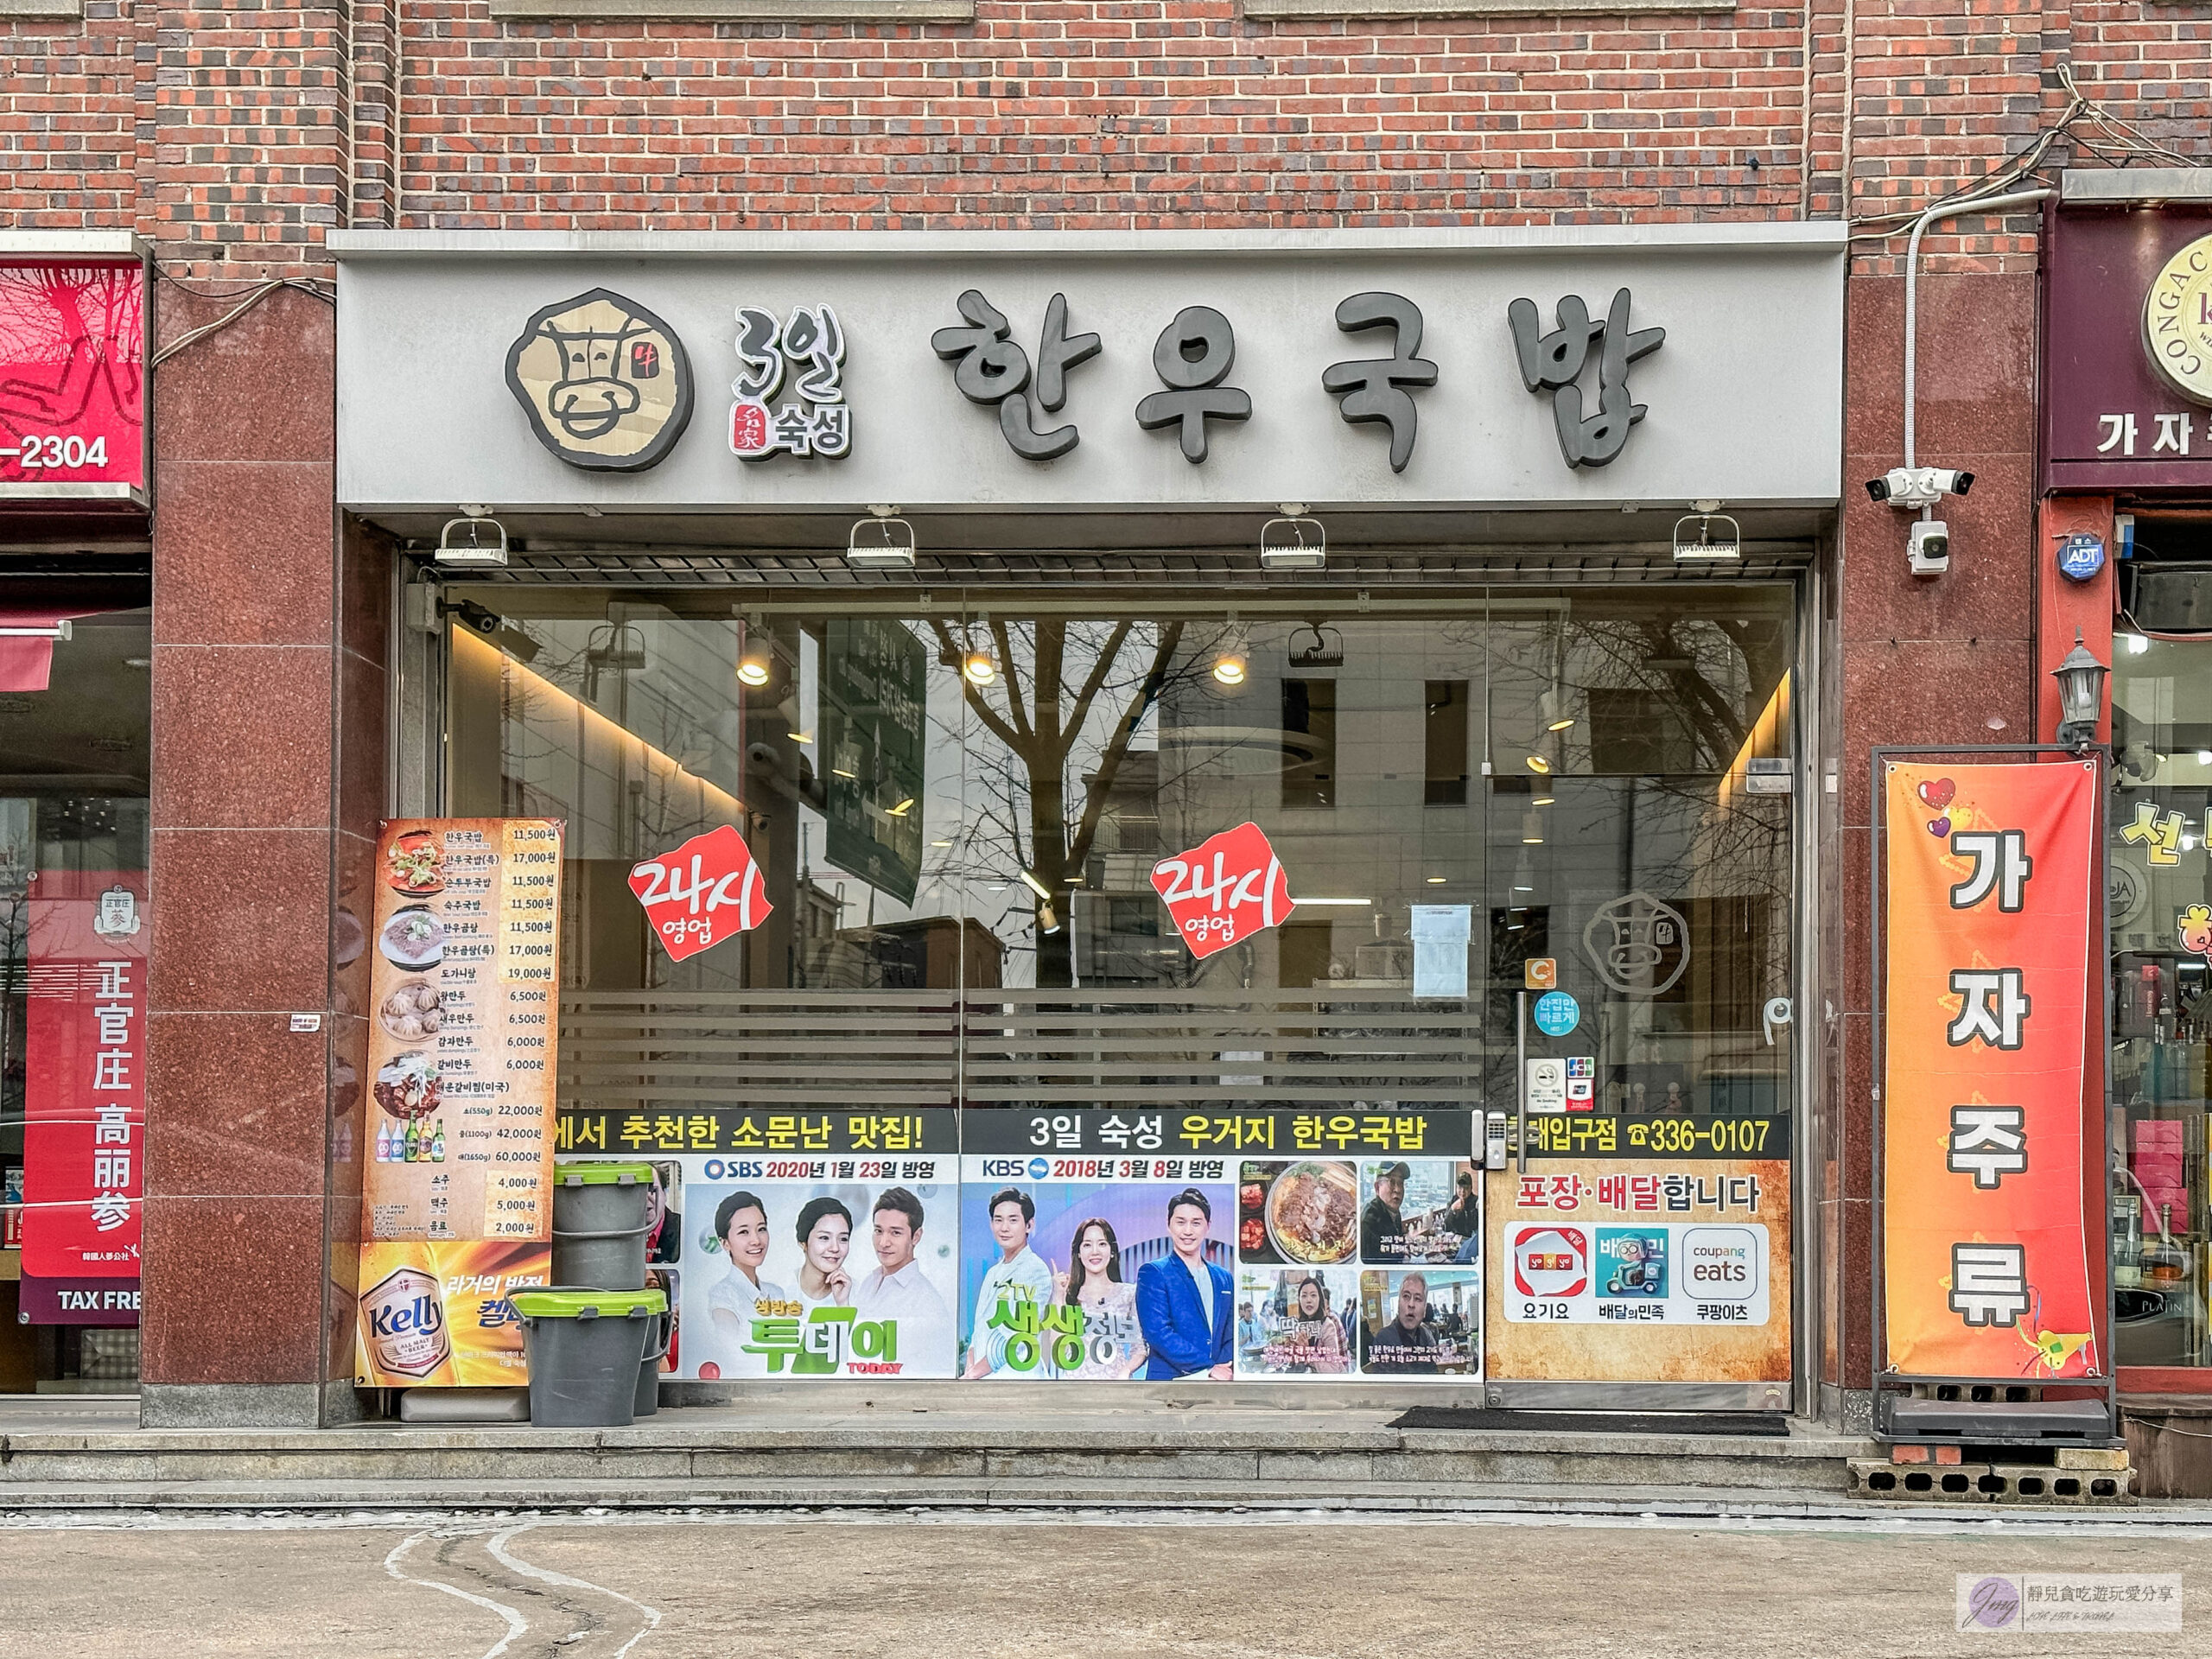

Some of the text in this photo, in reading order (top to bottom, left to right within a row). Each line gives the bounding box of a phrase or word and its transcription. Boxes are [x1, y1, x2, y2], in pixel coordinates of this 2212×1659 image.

[734, 304, 845, 402] 3일
[931, 287, 1666, 473] 한우국밥
[774, 404, 849, 454] 숙성
[2097, 412, 2212, 455] 가자
[2068, 548, 2099, 564] ADT
[513, 829, 556, 841] 11,500원
[512, 852, 556, 864] 17,000원
[512, 874, 554, 887] 11,500원
[1154, 850, 1280, 928] 24시
[632, 853, 758, 931] 24시
[512, 898, 553, 910] 11,500원
[510, 920, 552, 933] 11,500원
[662, 917, 712, 944] 영업
[1185, 914, 1236, 941] 영업
[509, 944, 552, 957] 17,000원
[508, 967, 550, 979] 19,000원
[510, 991, 546, 1002] 6,500원
[92, 960, 134, 1091] 正官庄
[509, 1014, 545, 1025] 6,500원
[507, 1037, 544, 1048] 6,000원
[506, 1059, 543, 1071] 6,000원
[1948, 830, 2033, 1327] 가자주류
[498, 1105, 543, 1116] 22,000원
[497, 1128, 541, 1139] 42,000원
[620, 1115, 720, 1150] 추천한
[731, 1116, 832, 1150] 소문난
[849, 1115, 923, 1150] 맛집!
[1029, 1115, 1427, 1150] 3일 숙성 우거지 한우국밥
[1650, 1120, 1770, 1152] 336-0107
[495, 1152, 540, 1162] 60,000원
[90, 1103, 133, 1233] 高丽参
[727, 1161, 935, 1179] SBS 2020년 1월 23일 방영
[982, 1160, 1025, 1177] KBS
[1053, 1160, 1115, 1178] 2018년
[1119, 1160, 1149, 1179] 3월
[1154, 1160, 1184, 1179] 8일
[1188, 1160, 1224, 1179] 방영
[431, 1174, 537, 1189] 소주 4,000원
[430, 1198, 536, 1211] 맥주 5,000원
[429, 1221, 535, 1234] 음료 2,000원
[1694, 1246, 1745, 1259] coupang
[1694, 1261, 1746, 1281] eats
[448, 1275, 499, 1294] 라거의
[57, 1291, 99, 1310] TAX
[369, 1294, 443, 1338] Kelly
[1522, 1303, 1748, 1320] 요기요 배달의민족 쿠팡이츠
[741, 1319, 897, 1373] 투데이
[846, 1362, 904, 1375] TODAY
